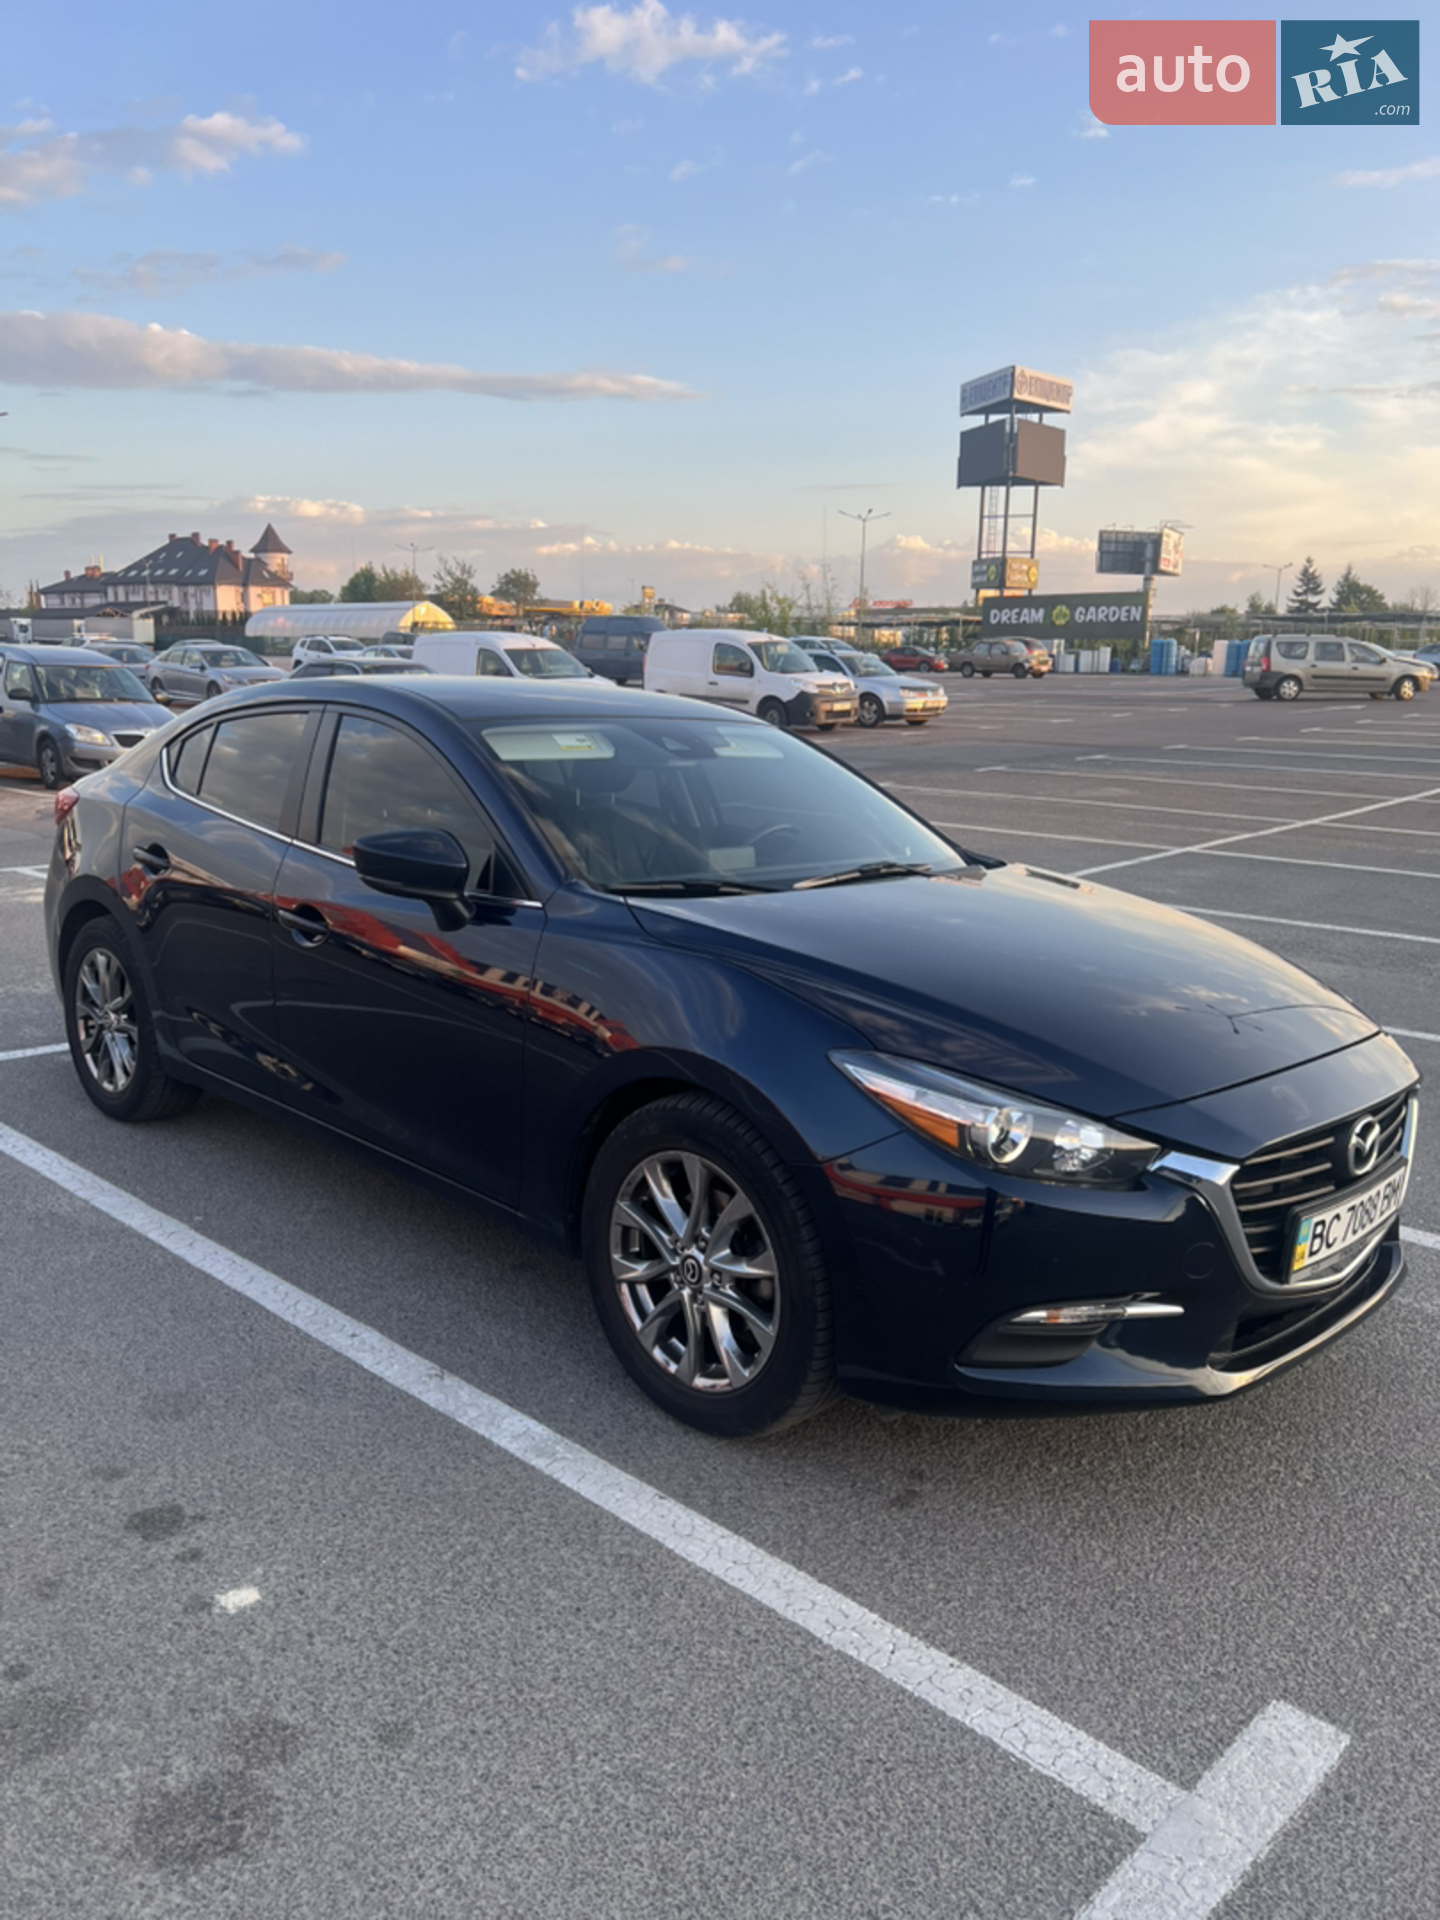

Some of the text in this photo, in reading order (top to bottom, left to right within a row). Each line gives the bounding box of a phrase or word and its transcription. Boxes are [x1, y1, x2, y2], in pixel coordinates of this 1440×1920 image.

[989, 605, 1143, 625] DREAM GARDEN
[1308, 1213, 1342, 1258] BC
